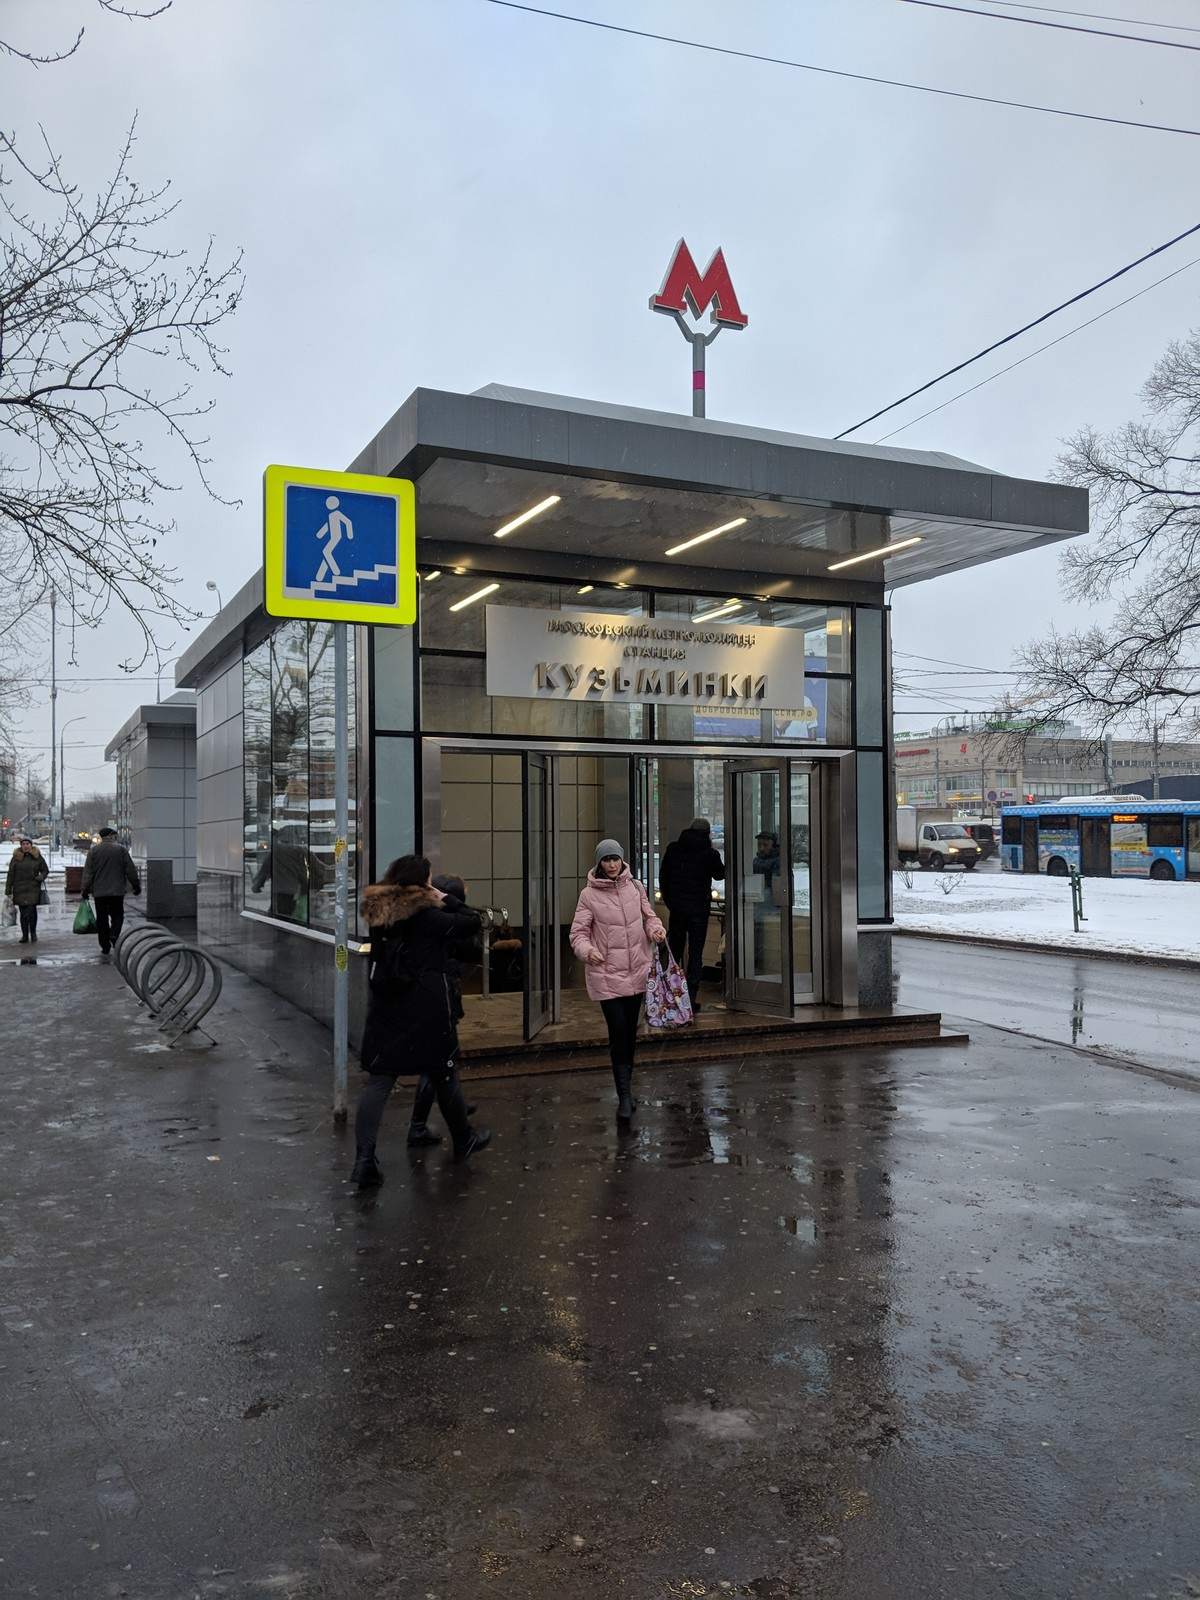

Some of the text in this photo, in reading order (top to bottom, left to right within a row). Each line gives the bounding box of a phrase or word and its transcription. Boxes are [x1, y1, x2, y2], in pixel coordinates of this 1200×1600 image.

[649, 237, 748, 327] М
[546, 620, 756, 646] МОСКОВСКИЙ МЕТРОПОЛИТЕН
[623, 647, 686, 660] СТАНЦИЯ
[536, 662, 768, 698] КУЗЬМИНКИ
